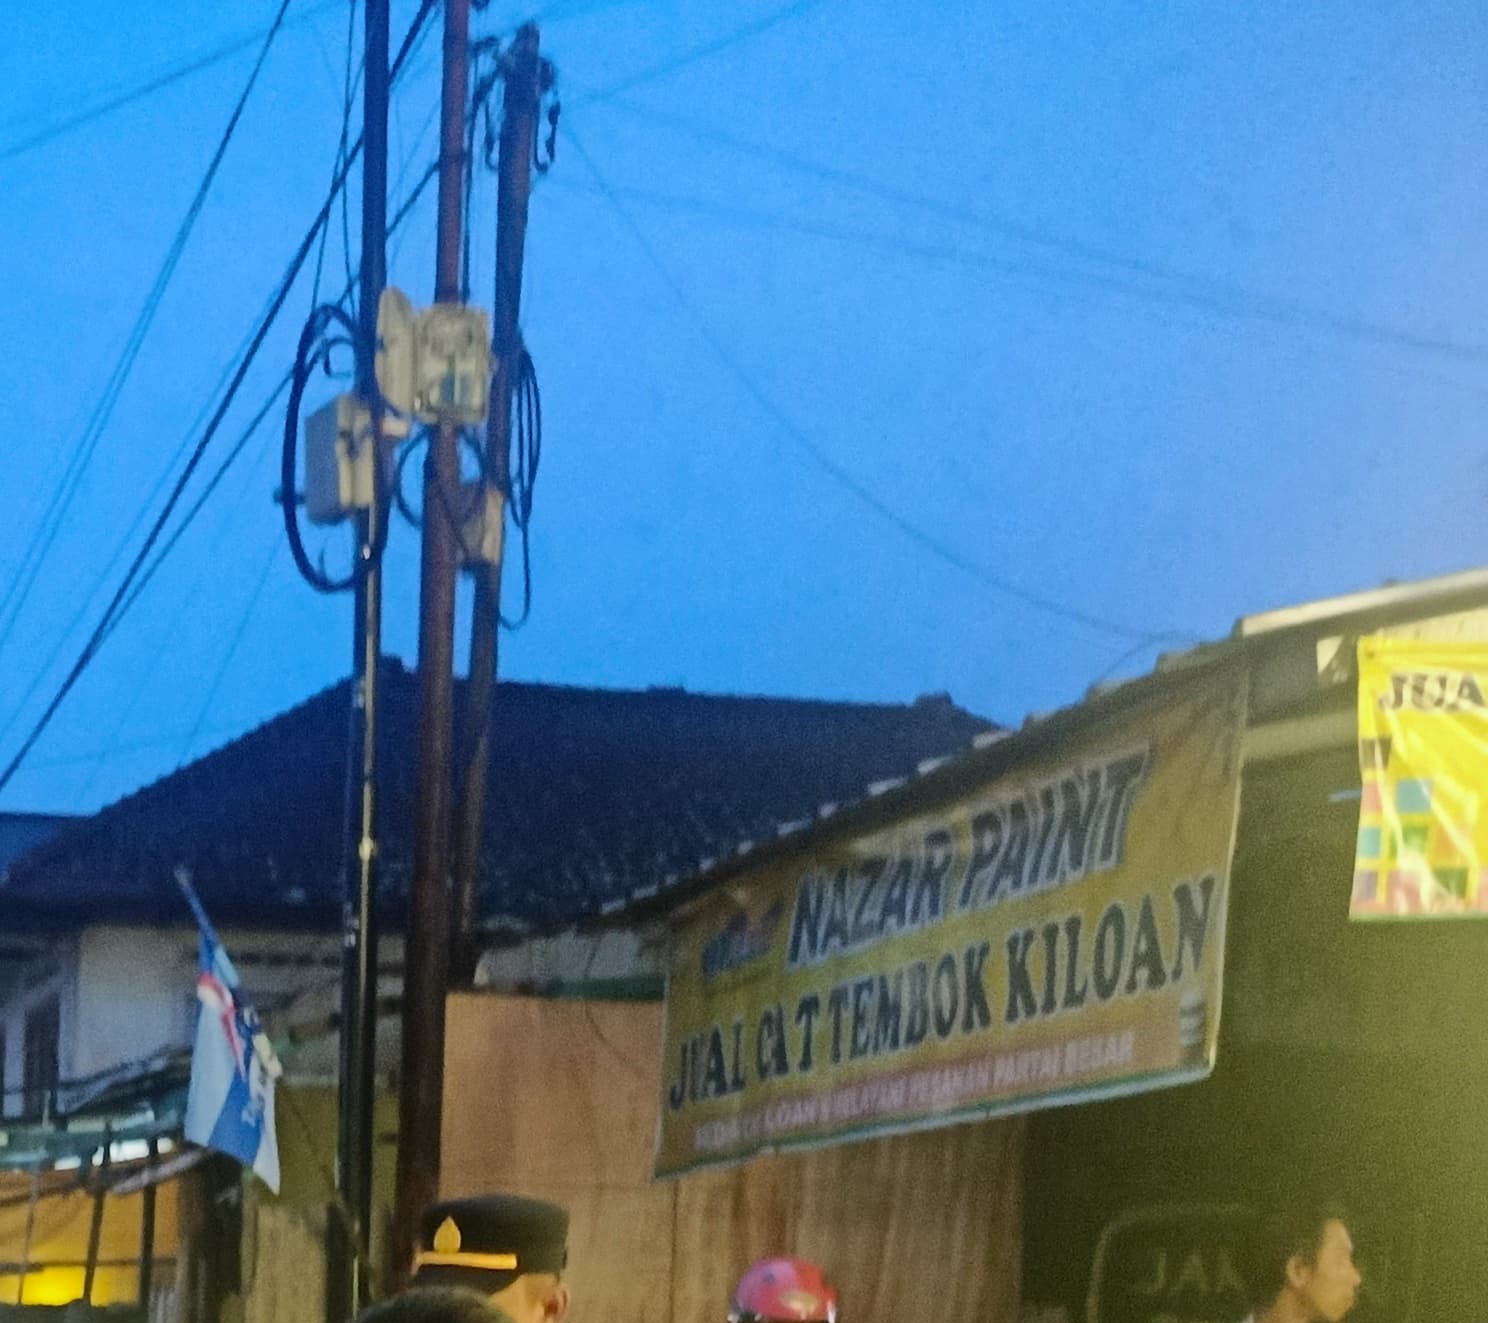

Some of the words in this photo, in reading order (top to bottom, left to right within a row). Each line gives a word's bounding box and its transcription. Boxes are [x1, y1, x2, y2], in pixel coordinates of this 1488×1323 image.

[791, 832, 952, 966] NAZAR
[961, 752, 1147, 906] PAINT
[828, 941, 990, 1064] TEMBOK
[1006, 876, 1215, 1023] KILOAN
